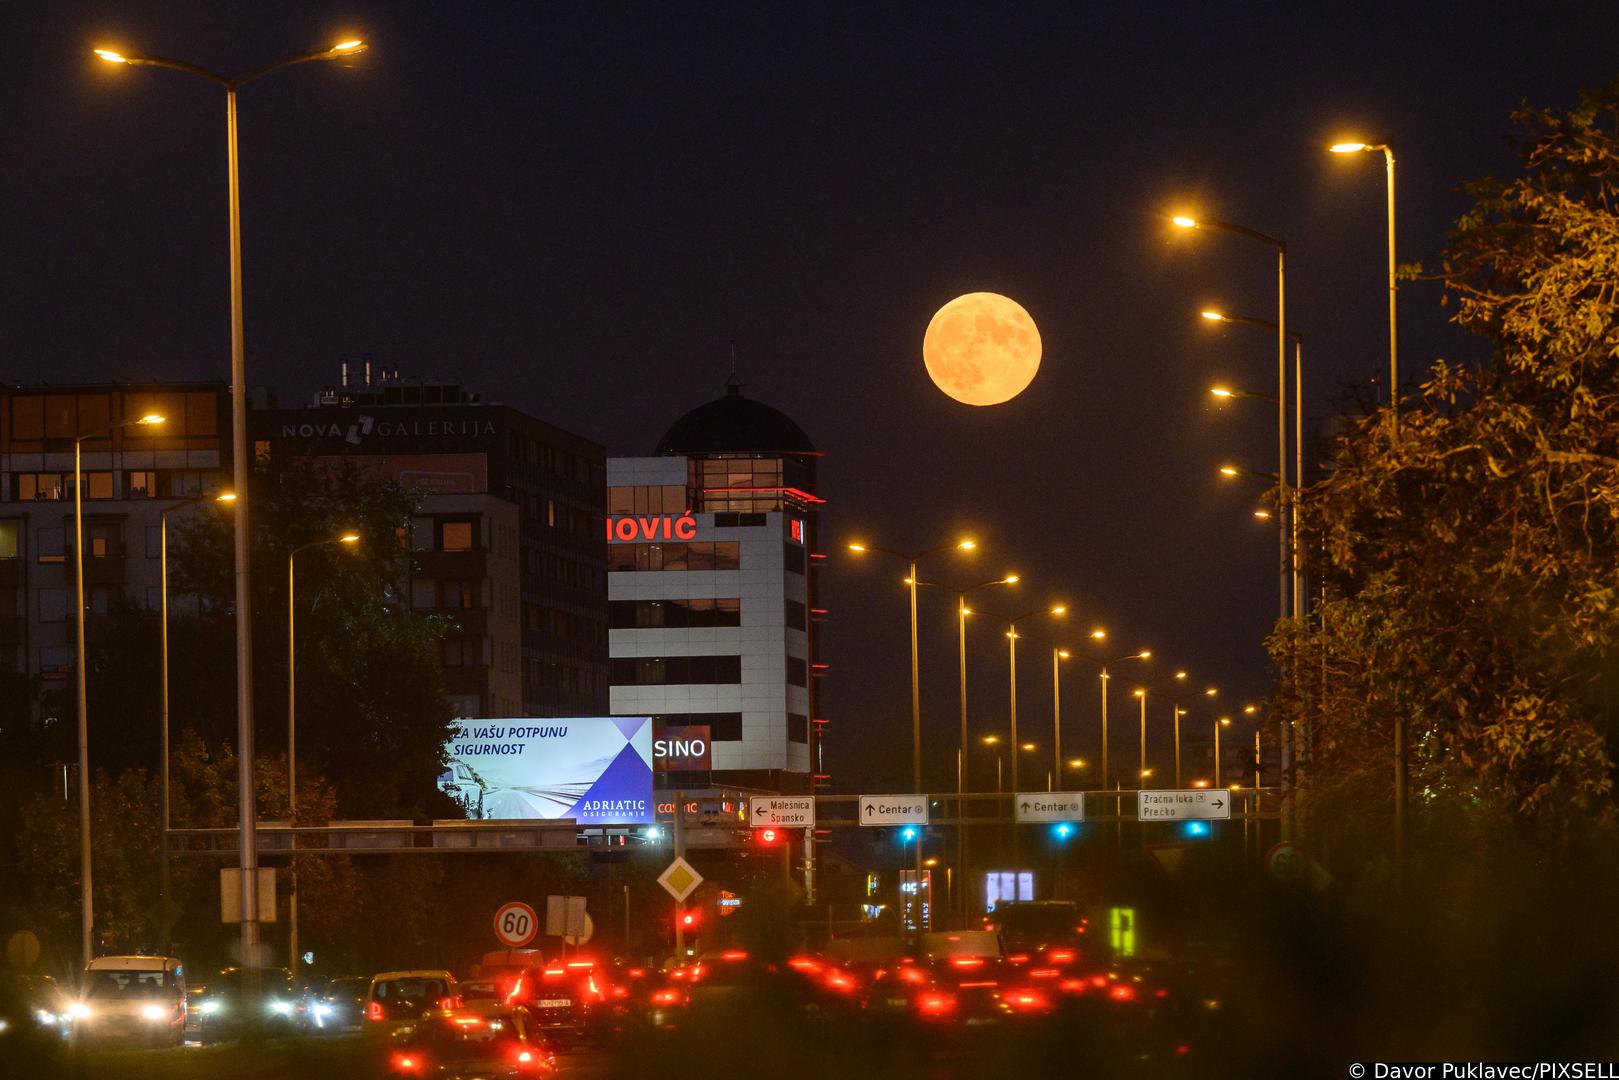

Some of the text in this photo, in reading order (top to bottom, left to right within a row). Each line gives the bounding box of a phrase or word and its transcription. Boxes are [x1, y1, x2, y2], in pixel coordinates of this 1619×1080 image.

[282, 419, 498, 438] NOVA GALERIJA
[473, 725, 505, 739] VAŠU
[508, 726, 568, 738] POTPUNU
[453, 743, 526, 756] SIGURNOST
[1175, 794, 1193, 803] luka
[583, 800, 645, 811] ADRIATIC
[770, 800, 810, 810] Malešnica
[878, 804, 913, 815] Centar
[1033, 802, 1068, 812] Centar
[770, 811, 805, 824] Špansko
[502, 912, 529, 936] 60
